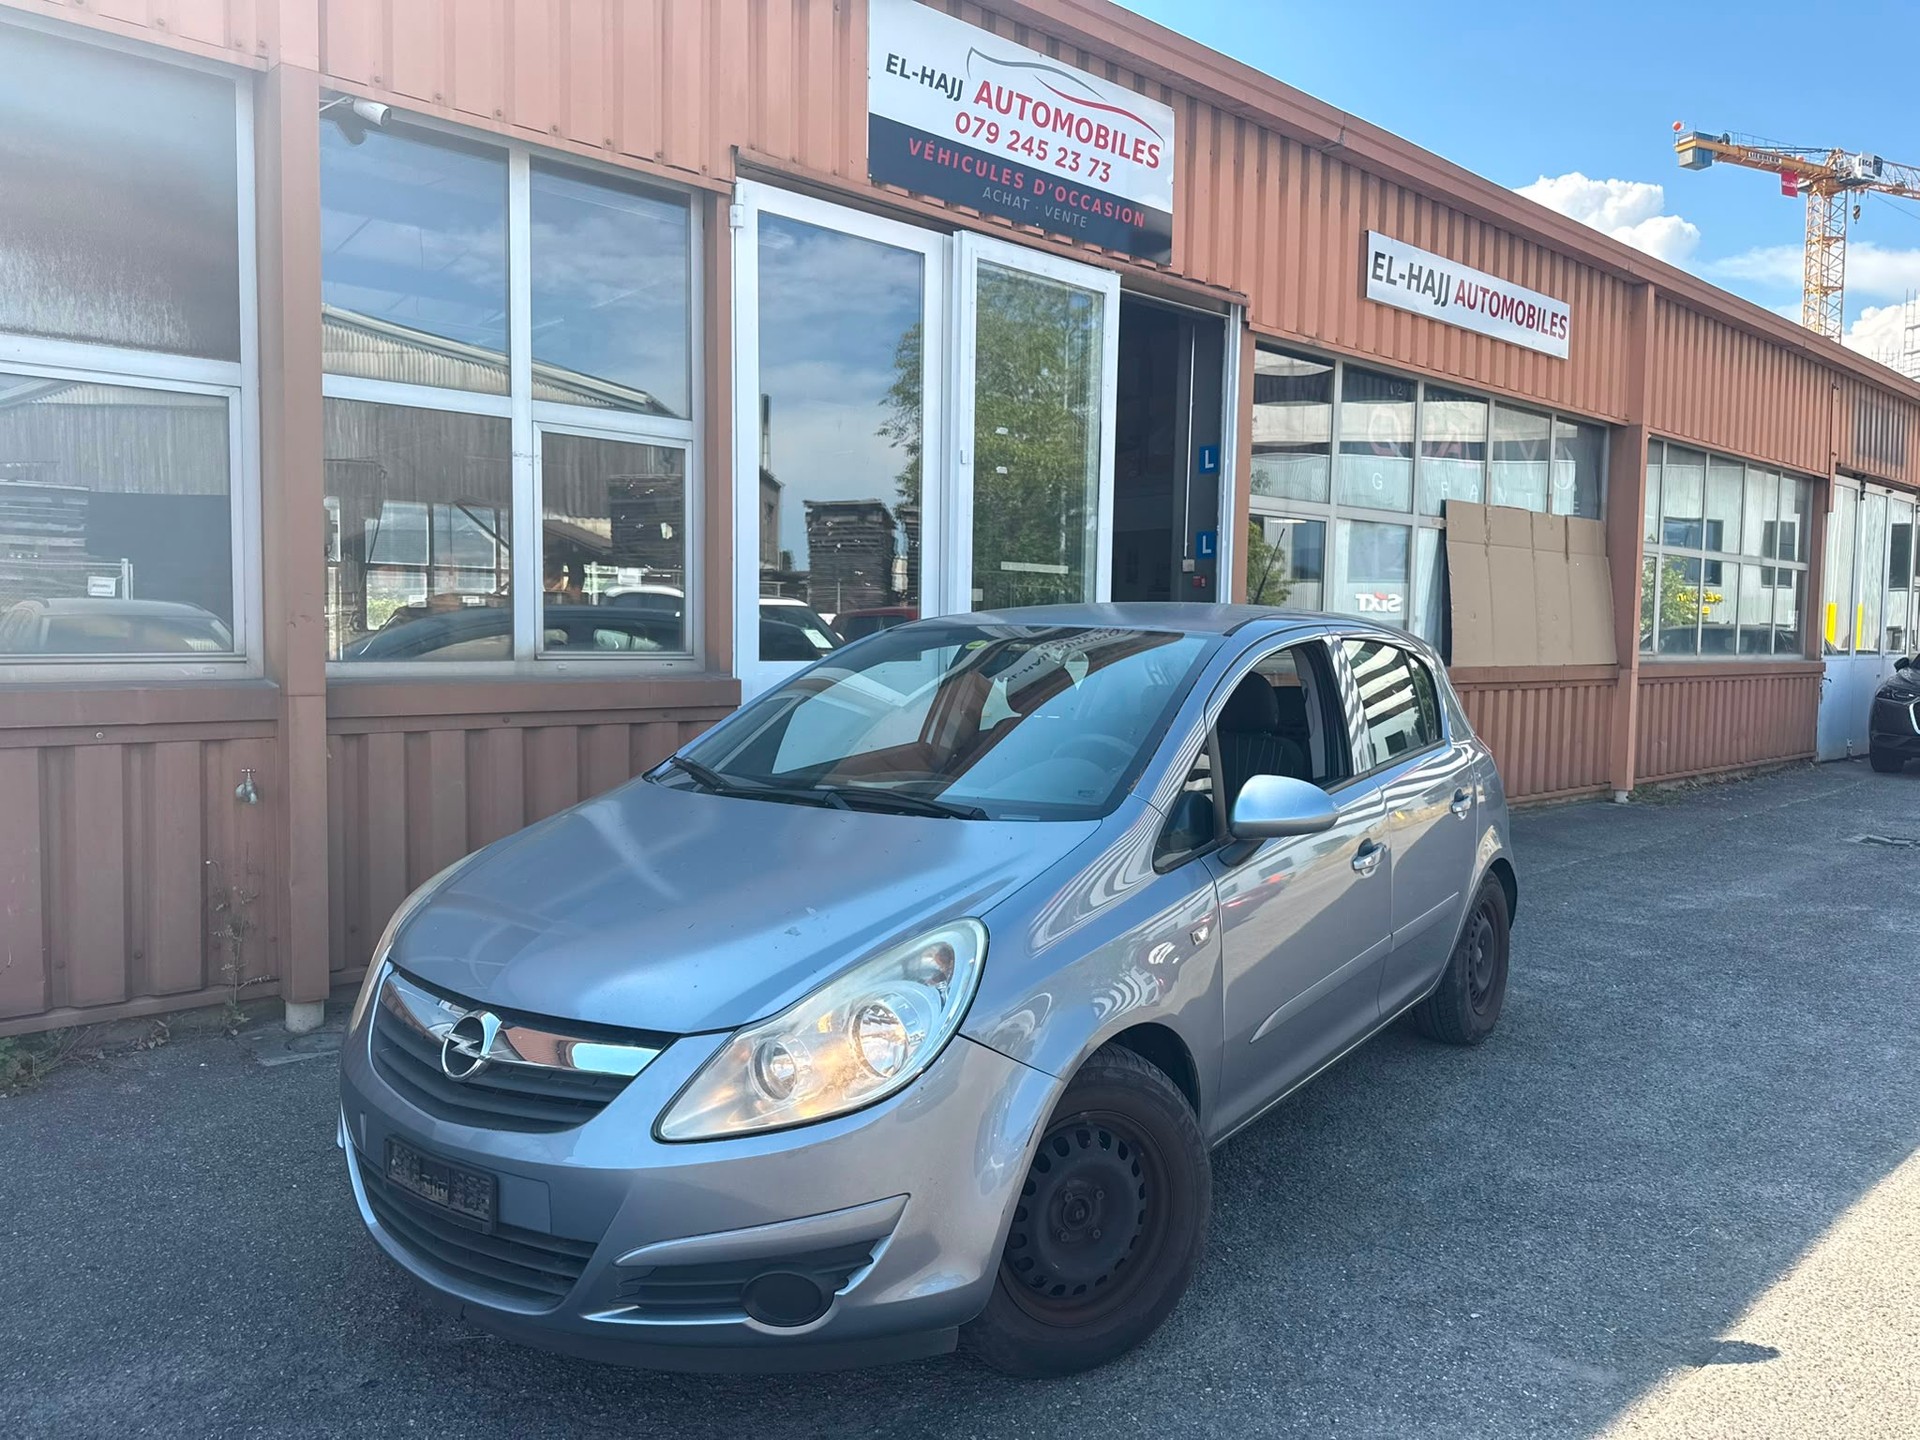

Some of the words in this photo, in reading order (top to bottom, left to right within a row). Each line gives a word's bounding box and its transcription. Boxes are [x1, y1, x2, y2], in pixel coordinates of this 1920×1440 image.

[885, 52, 964, 102] EL-HAJJ
[972, 79, 1161, 169] AUTOMOBILES
[908, 132, 1025, 189] VÉHICULES
[1033, 177, 1146, 229] D'OCCASION
[955, 111, 1000, 144] 079
[1006, 129, 1049, 161] 245
[1054, 146, 1081, 173] 23
[1086, 157, 1112, 183] 73
[982, 186, 1031, 212] ACHAT
[1043, 204, 1088, 229] VENTE
[1371, 250, 1451, 307] EL-HAJJ
[1453, 279, 1568, 340] AUTOMOBILES
[1204, 449, 1215, 469] L
[1202, 535, 1212, 554] L
